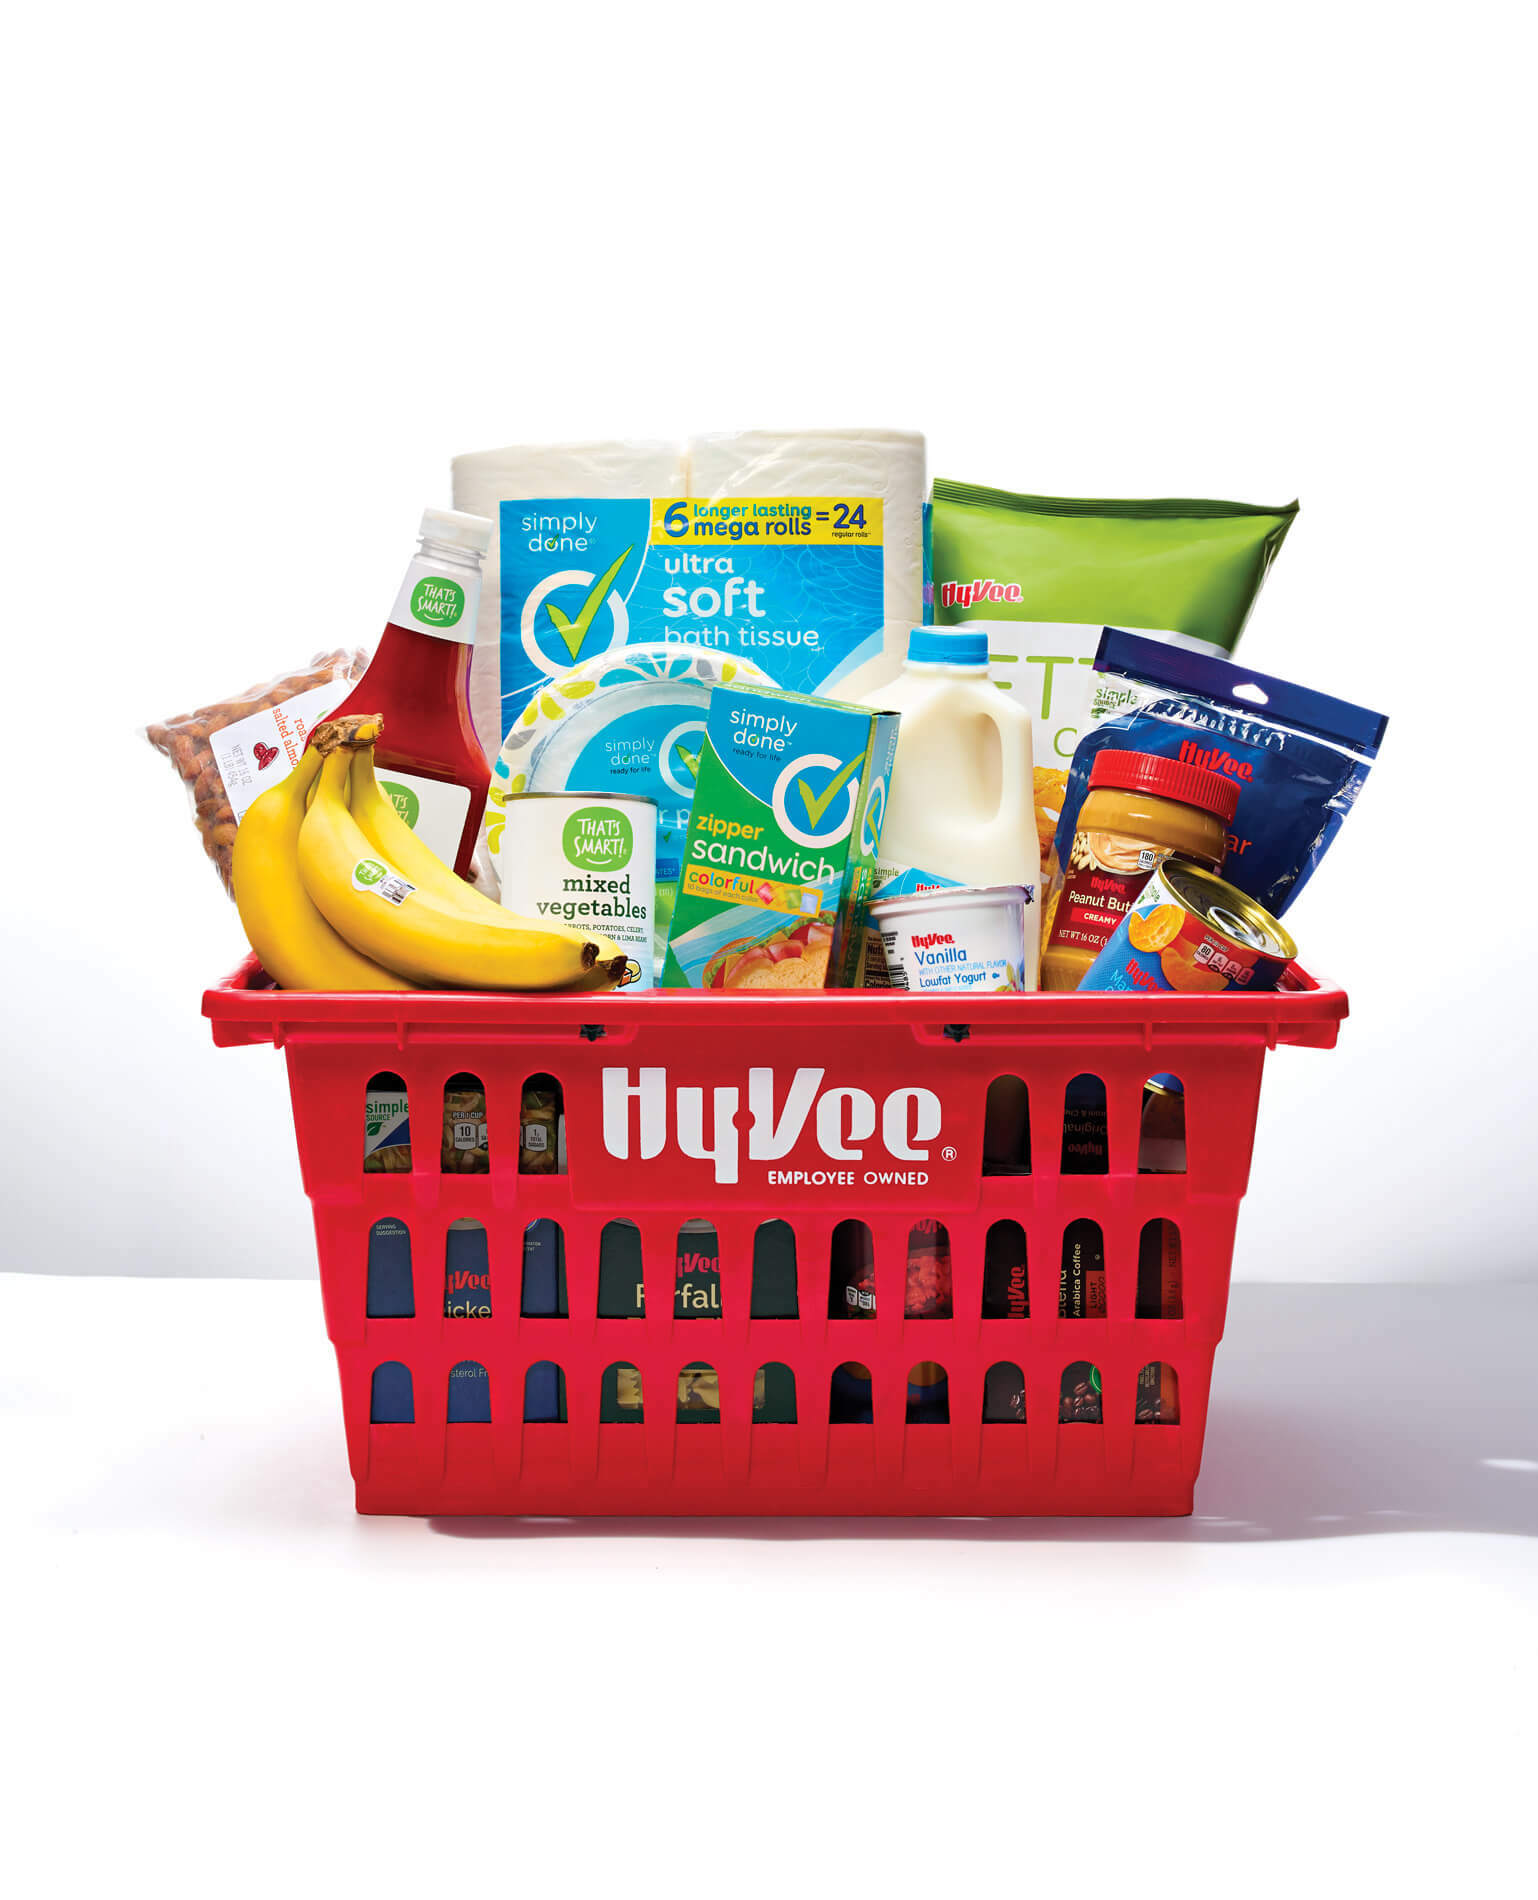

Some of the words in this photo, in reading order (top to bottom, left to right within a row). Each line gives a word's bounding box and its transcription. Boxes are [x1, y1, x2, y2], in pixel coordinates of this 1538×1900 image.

[664, 501, 689, 538] 6
[693, 503, 748, 519] longer
[753, 503, 812, 520] lasting
[521, 511, 598, 533] simply
[694, 518, 760, 540] mega
[764, 517, 812, 536] rolls
[528, 534, 588, 553] done
[664, 553, 734, 575] ultra
[662, 577, 767, 618] soft
[941, 580, 1022, 608] HyVee
[665, 625, 732, 647] bath
[739, 626, 820, 647] tissue
[1096, 686, 1138, 706] simple
[729, 708, 798, 737] simply
[272, 708, 294, 738] salted
[283, 739, 300, 769] almo
[605, 736, 655, 752] simply
[733, 728, 786, 752] done
[610, 752, 650, 766] done
[1179, 740, 1254, 783] HyVee
[610, 767, 628, 775] ready
[640, 766, 651, 774] life
[577, 819, 620, 836] THAT'S
[696, 813, 764, 840] zipper
[574, 836, 624, 858] SMART!
[1227, 833, 1253, 857] ar
[691, 839, 835, 885] sandwich
[1141, 851, 1154, 862] 180
[874, 867, 899, 877] simple
[562, 874, 631, 895] mixed
[689, 871, 755, 895] colorful
[1091, 876, 1126, 895] HyVee
[536, 897, 647, 920] vegetables
[1068, 890, 1107, 908] Peanut
[1107, 896, 1133, 913] But
[1083, 913, 1117, 925] CREAMY
[911, 933, 955, 949] HyVee
[1059, 929, 1069, 938] NET
[1070, 930, 1081, 940] WT
[1081, 931, 1088, 941] 16
[1088, 933, 1099, 944] OZ
[914, 947, 967, 966] Vanilla
[919, 967, 933, 976] WITH
[934, 964, 955, 975] OTHER
[957, 961, 984, 972] NATURAL
[986, 959, 1007, 968] FLAVOR
[919, 975, 951, 988] Lowfat
[954, 971, 986, 984] Yogurt
[366, 1099, 409, 1117] simple
[366, 1113, 391, 1121] SOURCE
[453, 1112, 465, 1120] PER
[470, 1112, 483, 1120] CUP
[460, 1126, 471, 1137] 10
[602, 1067, 942, 1184] HyVee
[768, 1171, 855, 1186] EMPLOYEE
[863, 1171, 929, 1186] OWNED
[1072, 1243, 1081, 1277] Coffee
[1072, 1279, 1081, 1317] Arabica
[448, 1300, 491, 1318] icke
[451, 1368, 476, 1378] sterol
